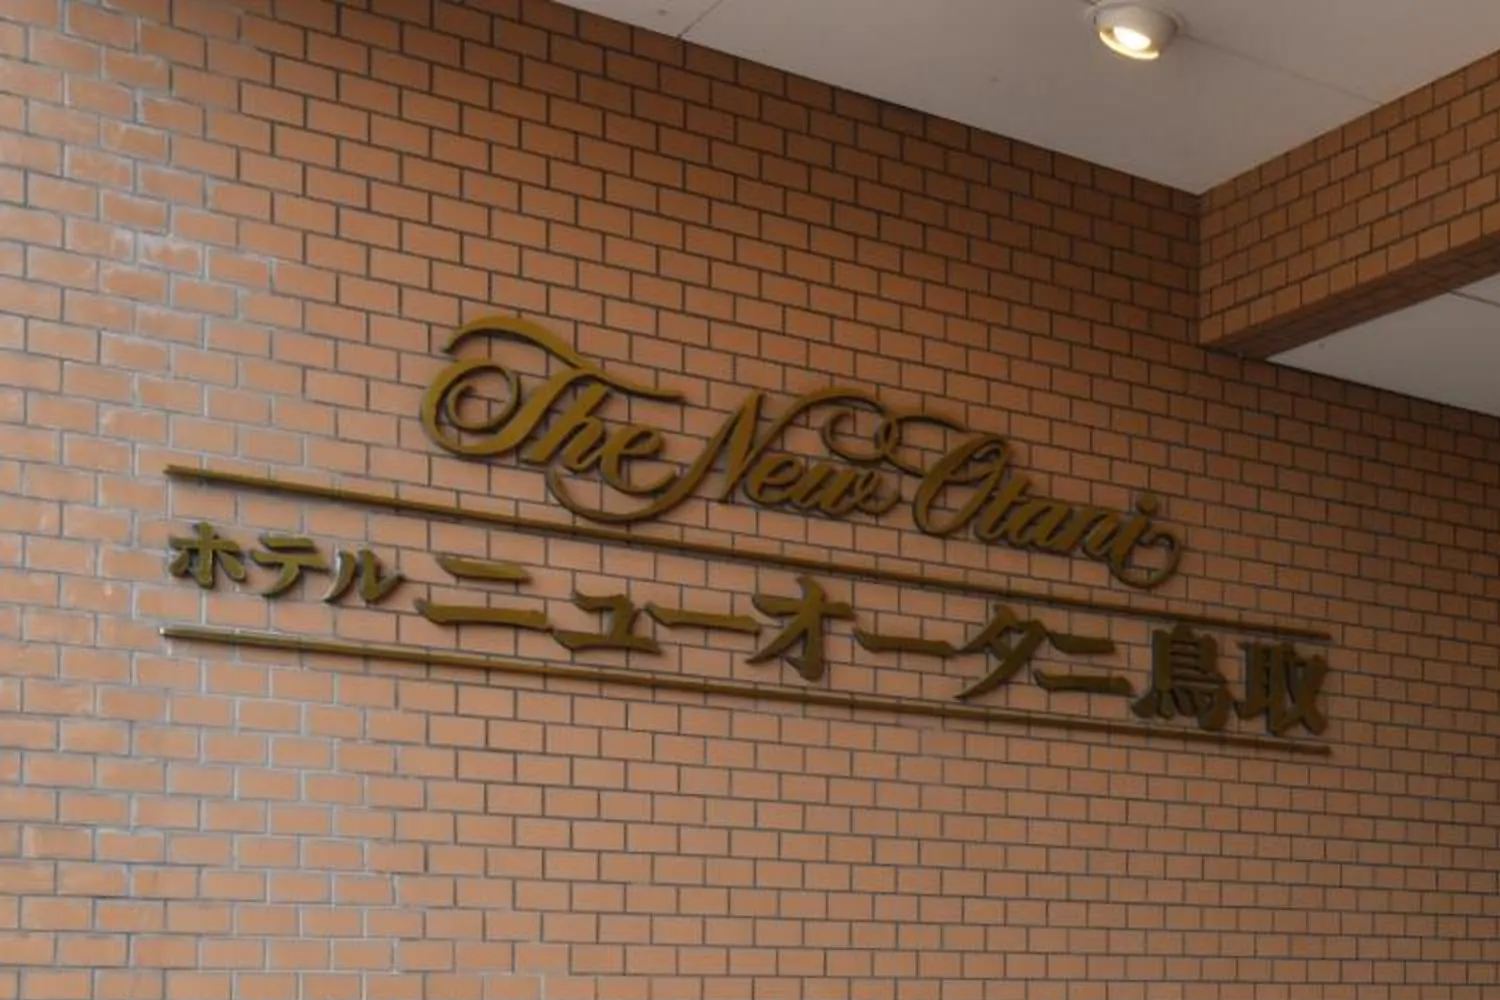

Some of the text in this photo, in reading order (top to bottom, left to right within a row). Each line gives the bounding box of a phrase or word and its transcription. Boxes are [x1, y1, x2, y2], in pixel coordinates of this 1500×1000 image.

[420, 315, 1183, 590] The New Otani
[166, 521, 1329, 738] ホテルニューオータニ鳥取
